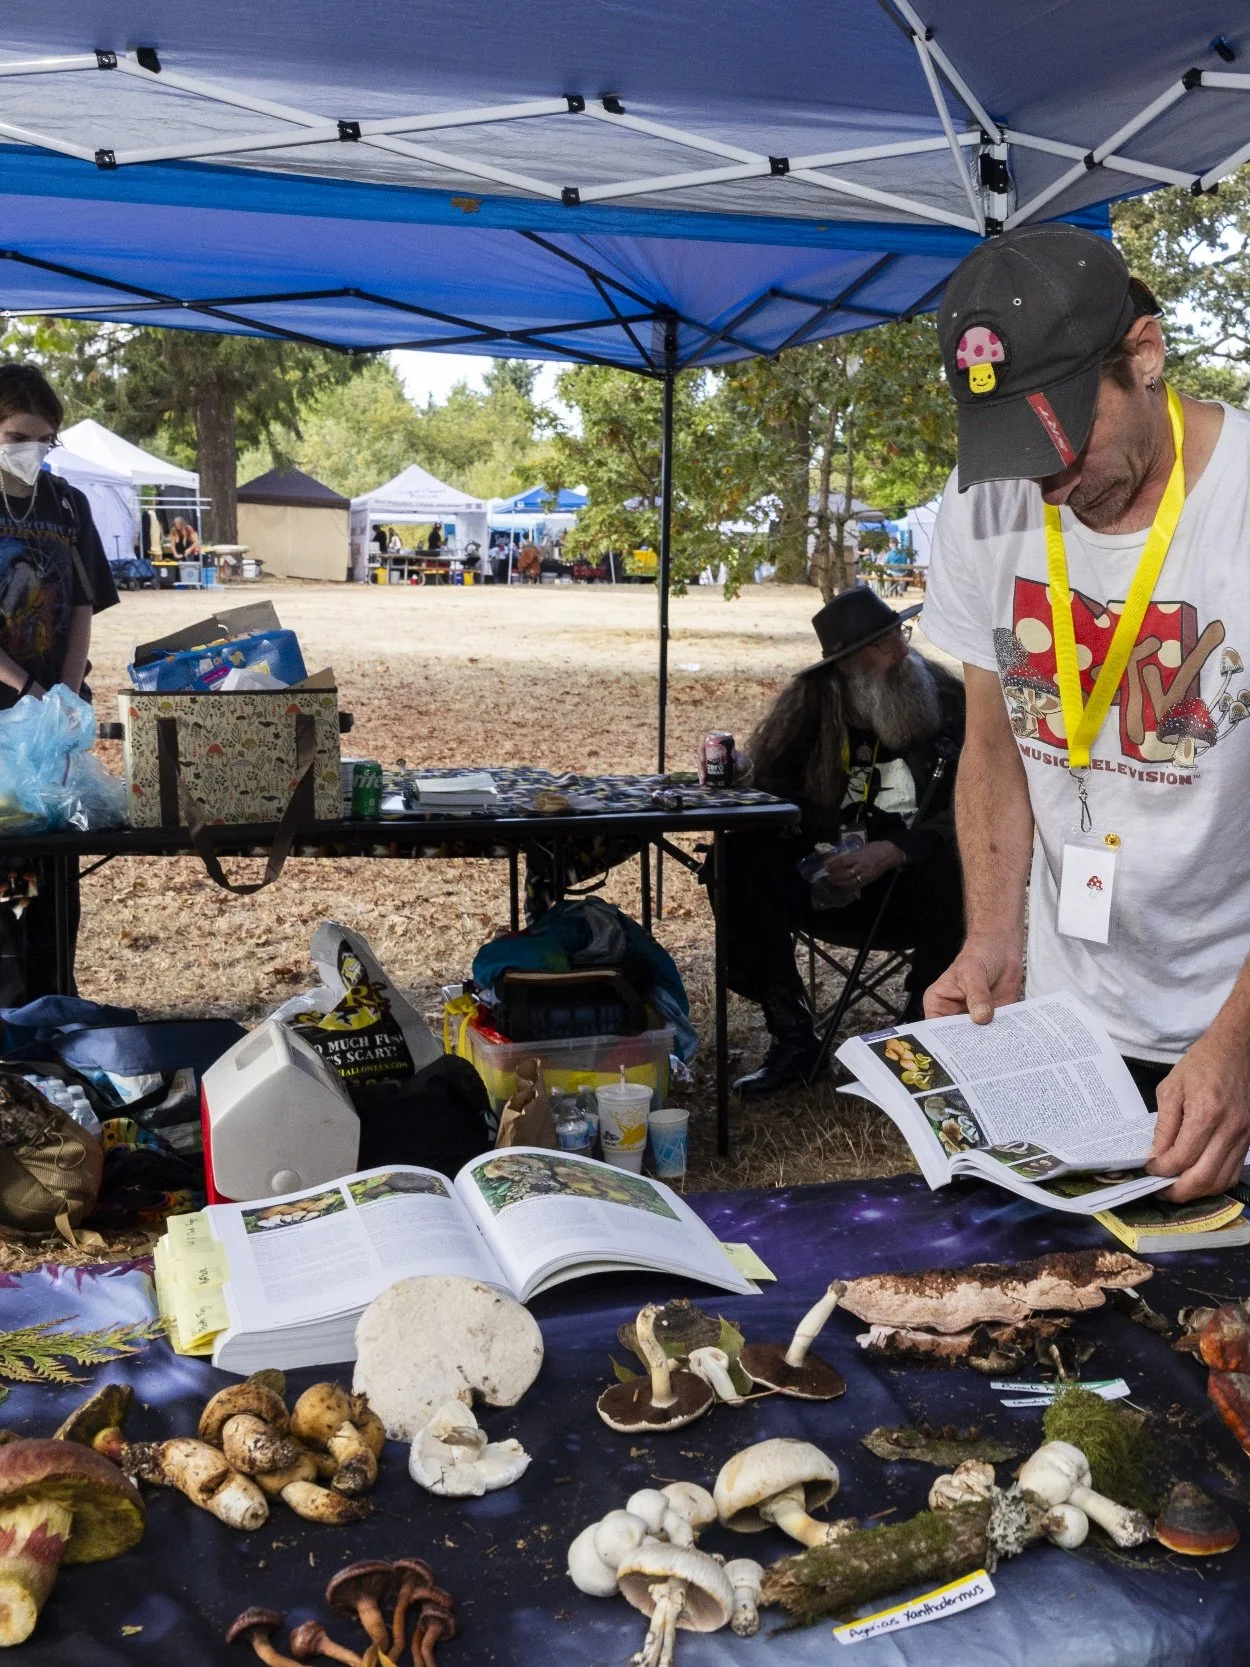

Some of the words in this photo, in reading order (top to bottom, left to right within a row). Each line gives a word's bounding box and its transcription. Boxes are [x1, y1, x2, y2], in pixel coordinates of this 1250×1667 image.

[1019, 744, 1070, 769] MUSIC
[327, 1035, 370, 1053] MUCH
[346, 1046, 398, 1064] SCARY!
[337, 1061, 409, 1077] HALLOWEEN.COM
